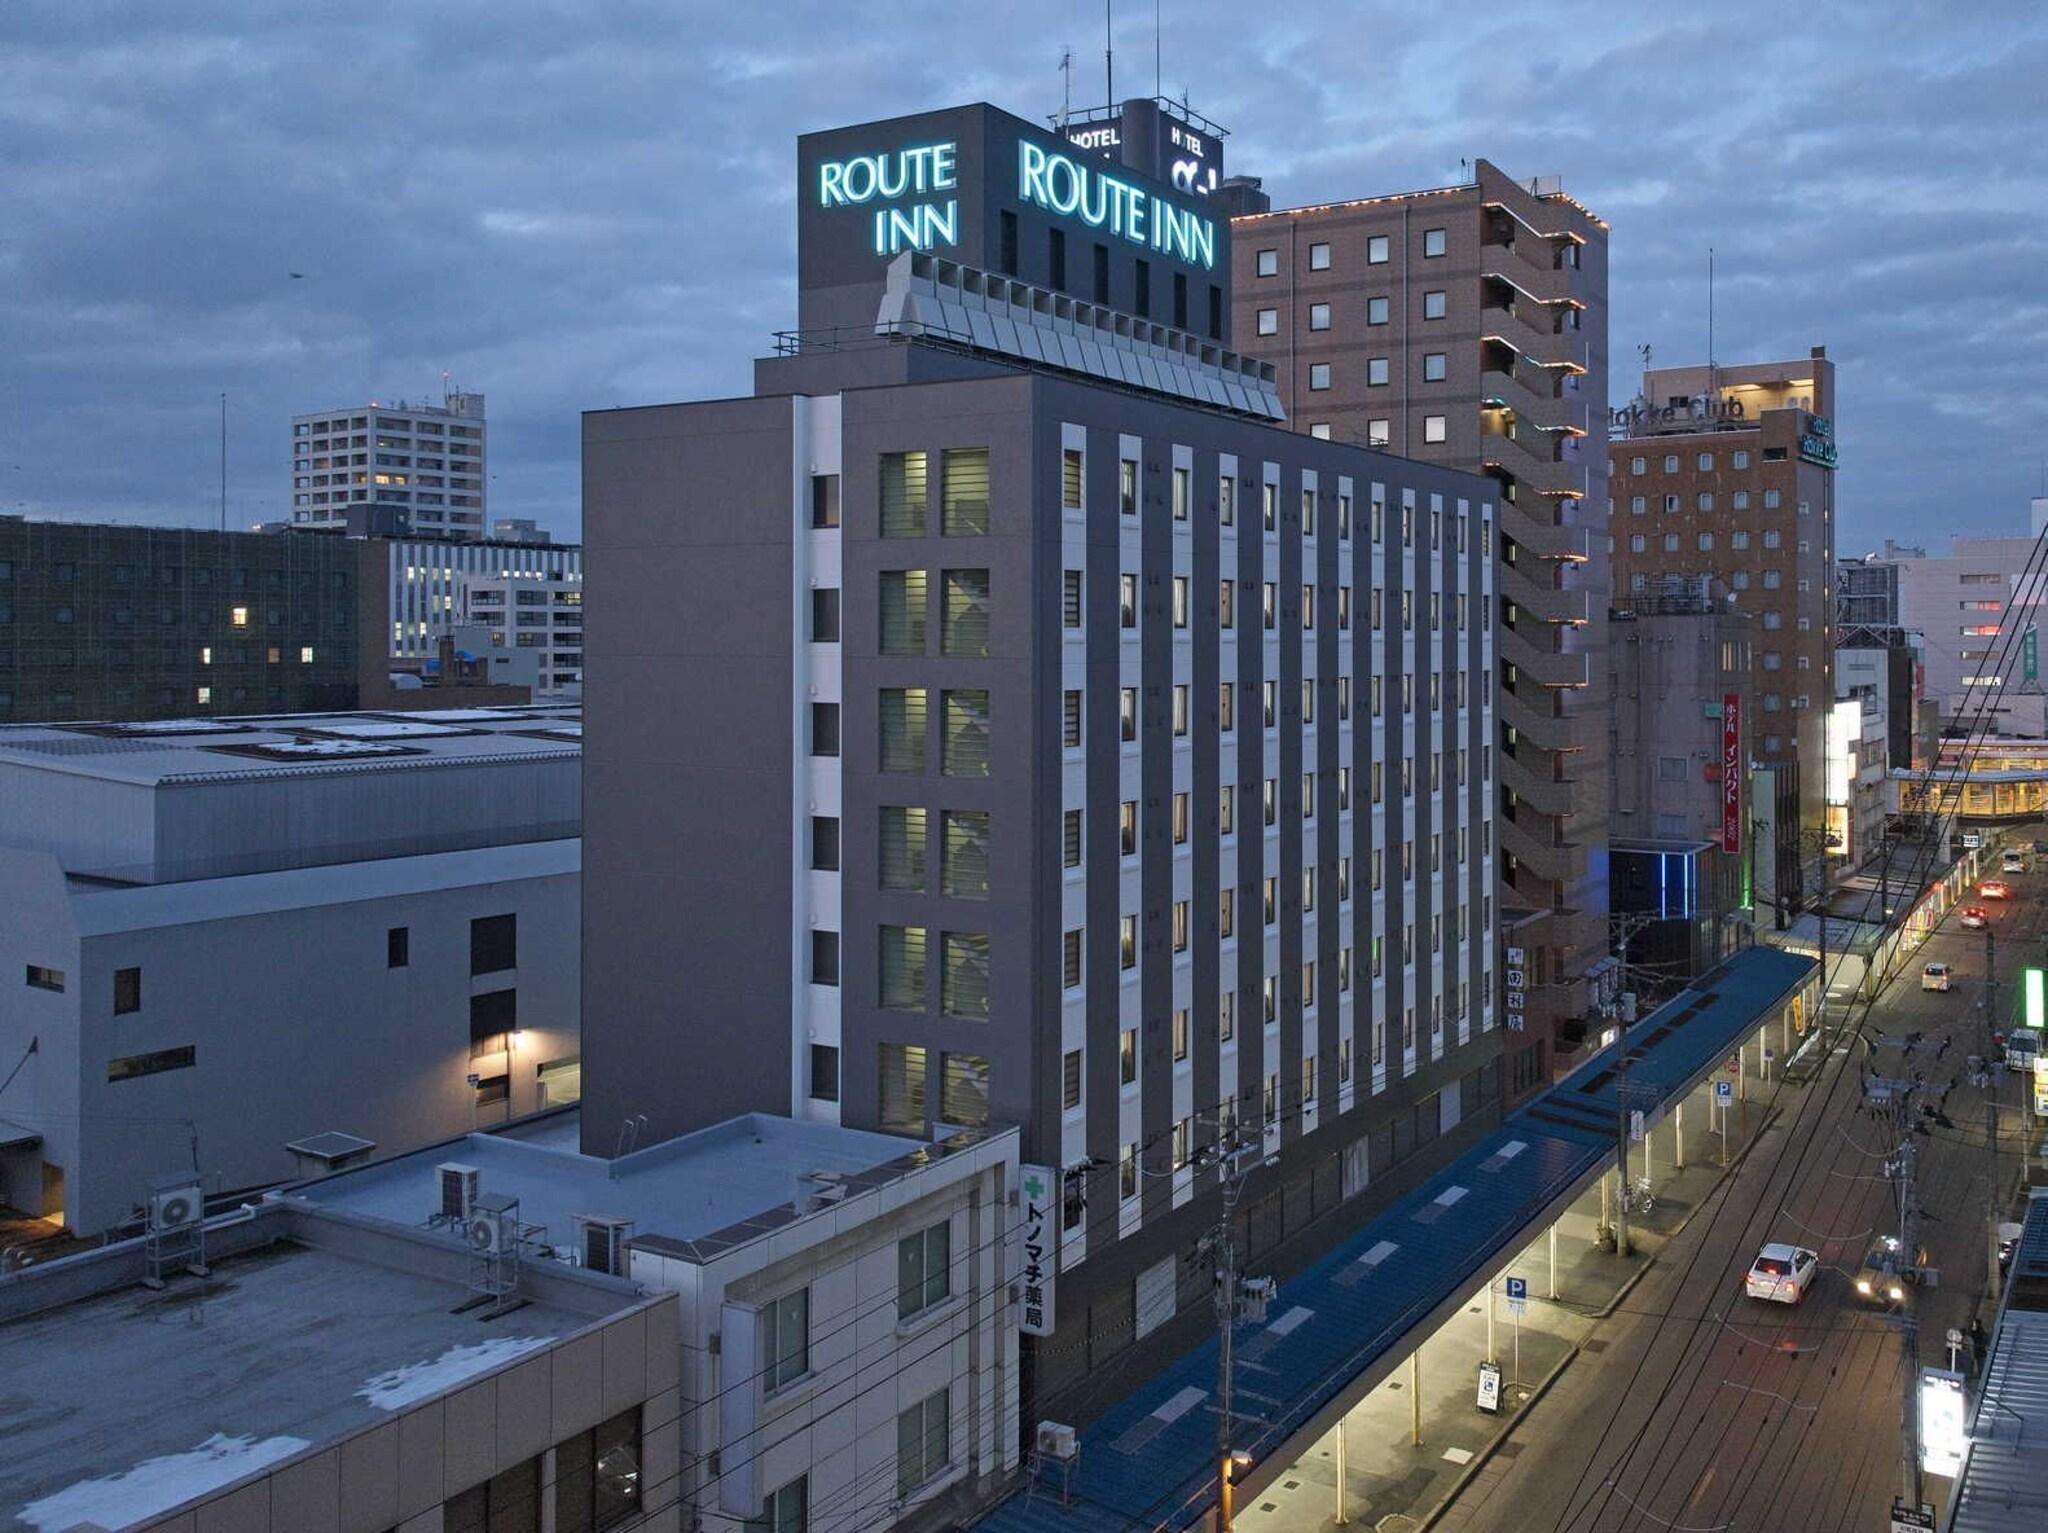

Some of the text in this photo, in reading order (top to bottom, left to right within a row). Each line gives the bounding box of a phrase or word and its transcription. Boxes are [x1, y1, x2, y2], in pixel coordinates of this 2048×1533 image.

[821, 143, 957, 207] ROUTE
[1019, 139, 1213, 270] ROUTE INN
[876, 200, 957, 255] INN
[1719, 1083, 1730, 1096] P
[1025, 1202, 1043, 1329] トノマチ薬局
[1511, 1279, 1523, 1296] P
